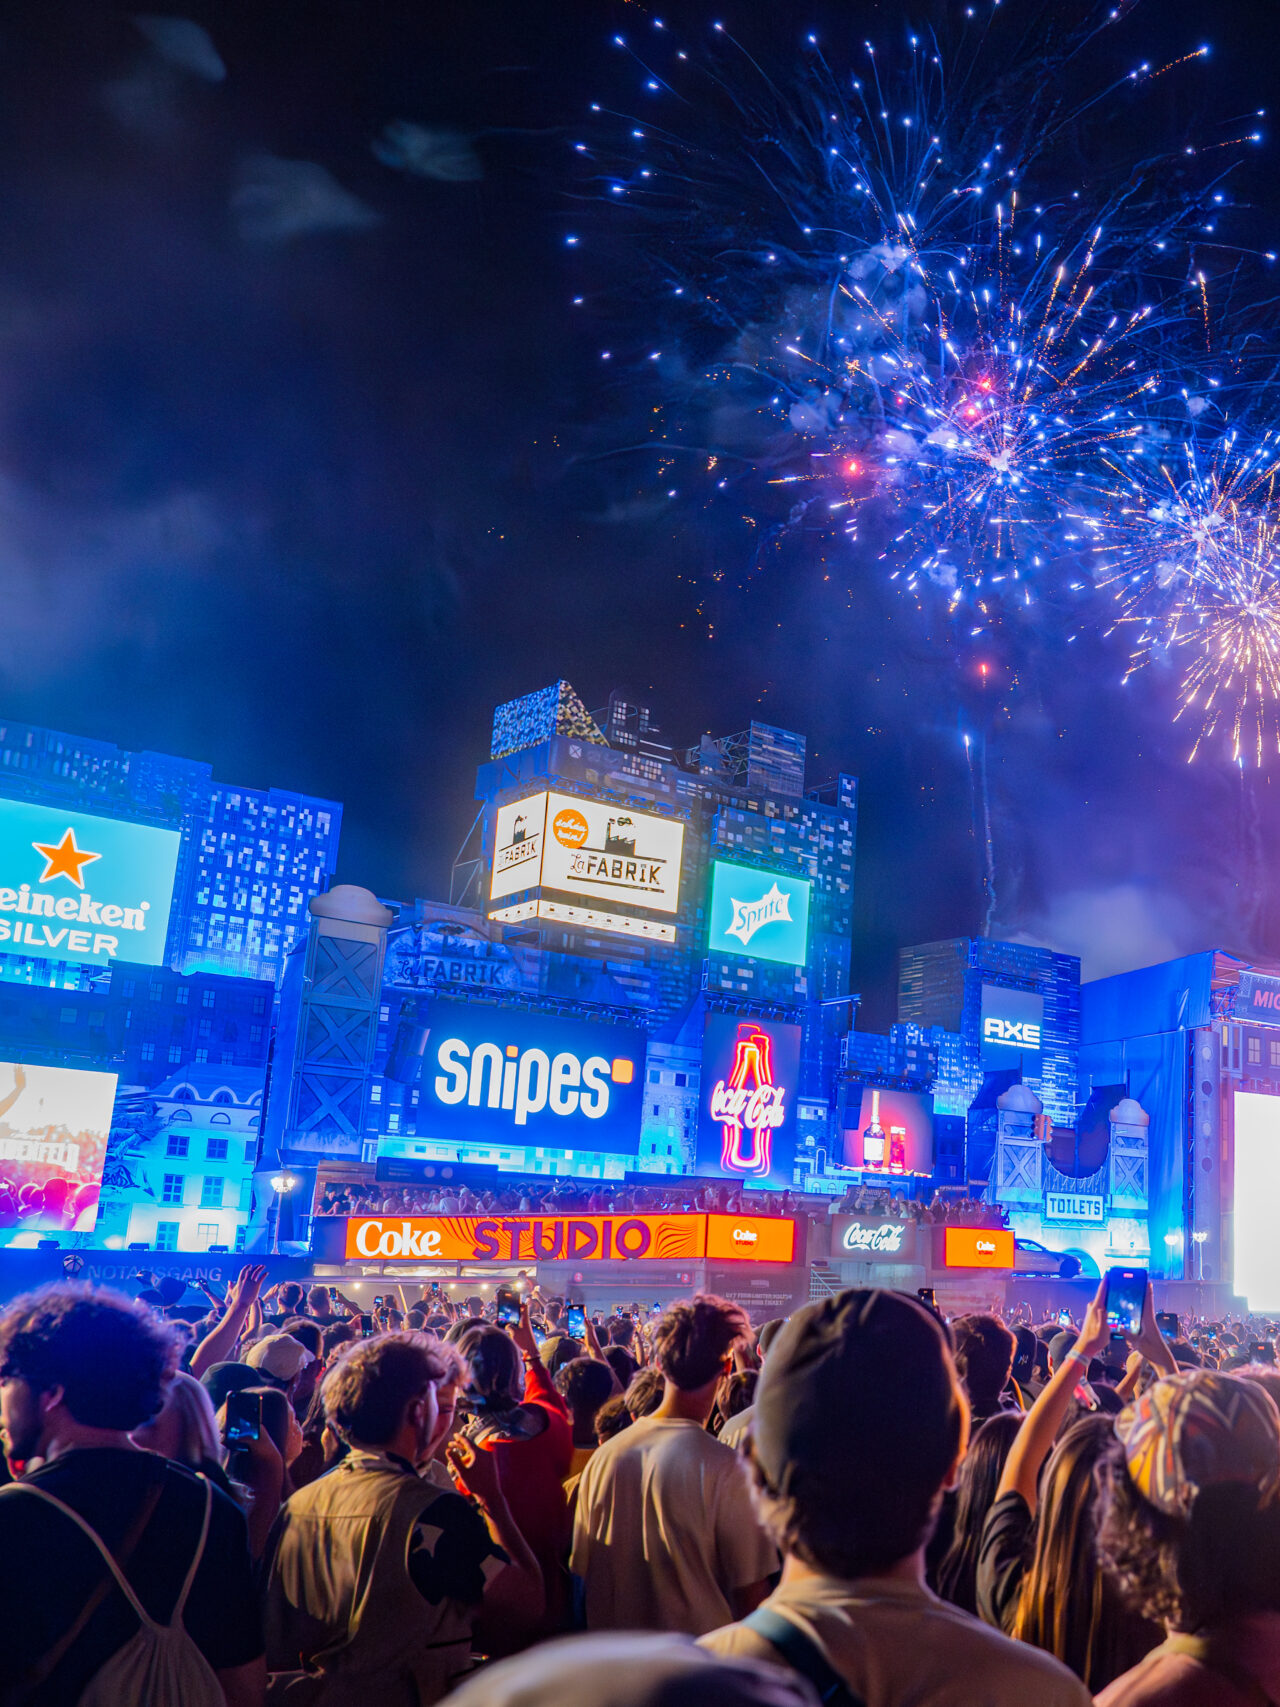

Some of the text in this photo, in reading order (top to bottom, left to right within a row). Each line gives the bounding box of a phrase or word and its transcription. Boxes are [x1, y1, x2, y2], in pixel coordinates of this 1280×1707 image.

[586, 855, 662, 885] FABRIK
[735, 897, 784, 931] Sprite
[423, 959, 503, 985] FABRIK
[984, 1017, 1041, 1044] AXE
[711, 1079, 786, 1129] Coca-Cola
[1049, 1197, 1101, 1216] TOILETS
[356, 1219, 651, 1260] Coke STUDIO
[843, 1222, 905, 1251] Coca-Cola
[87, 1264, 222, 1283] NOTASGANG
